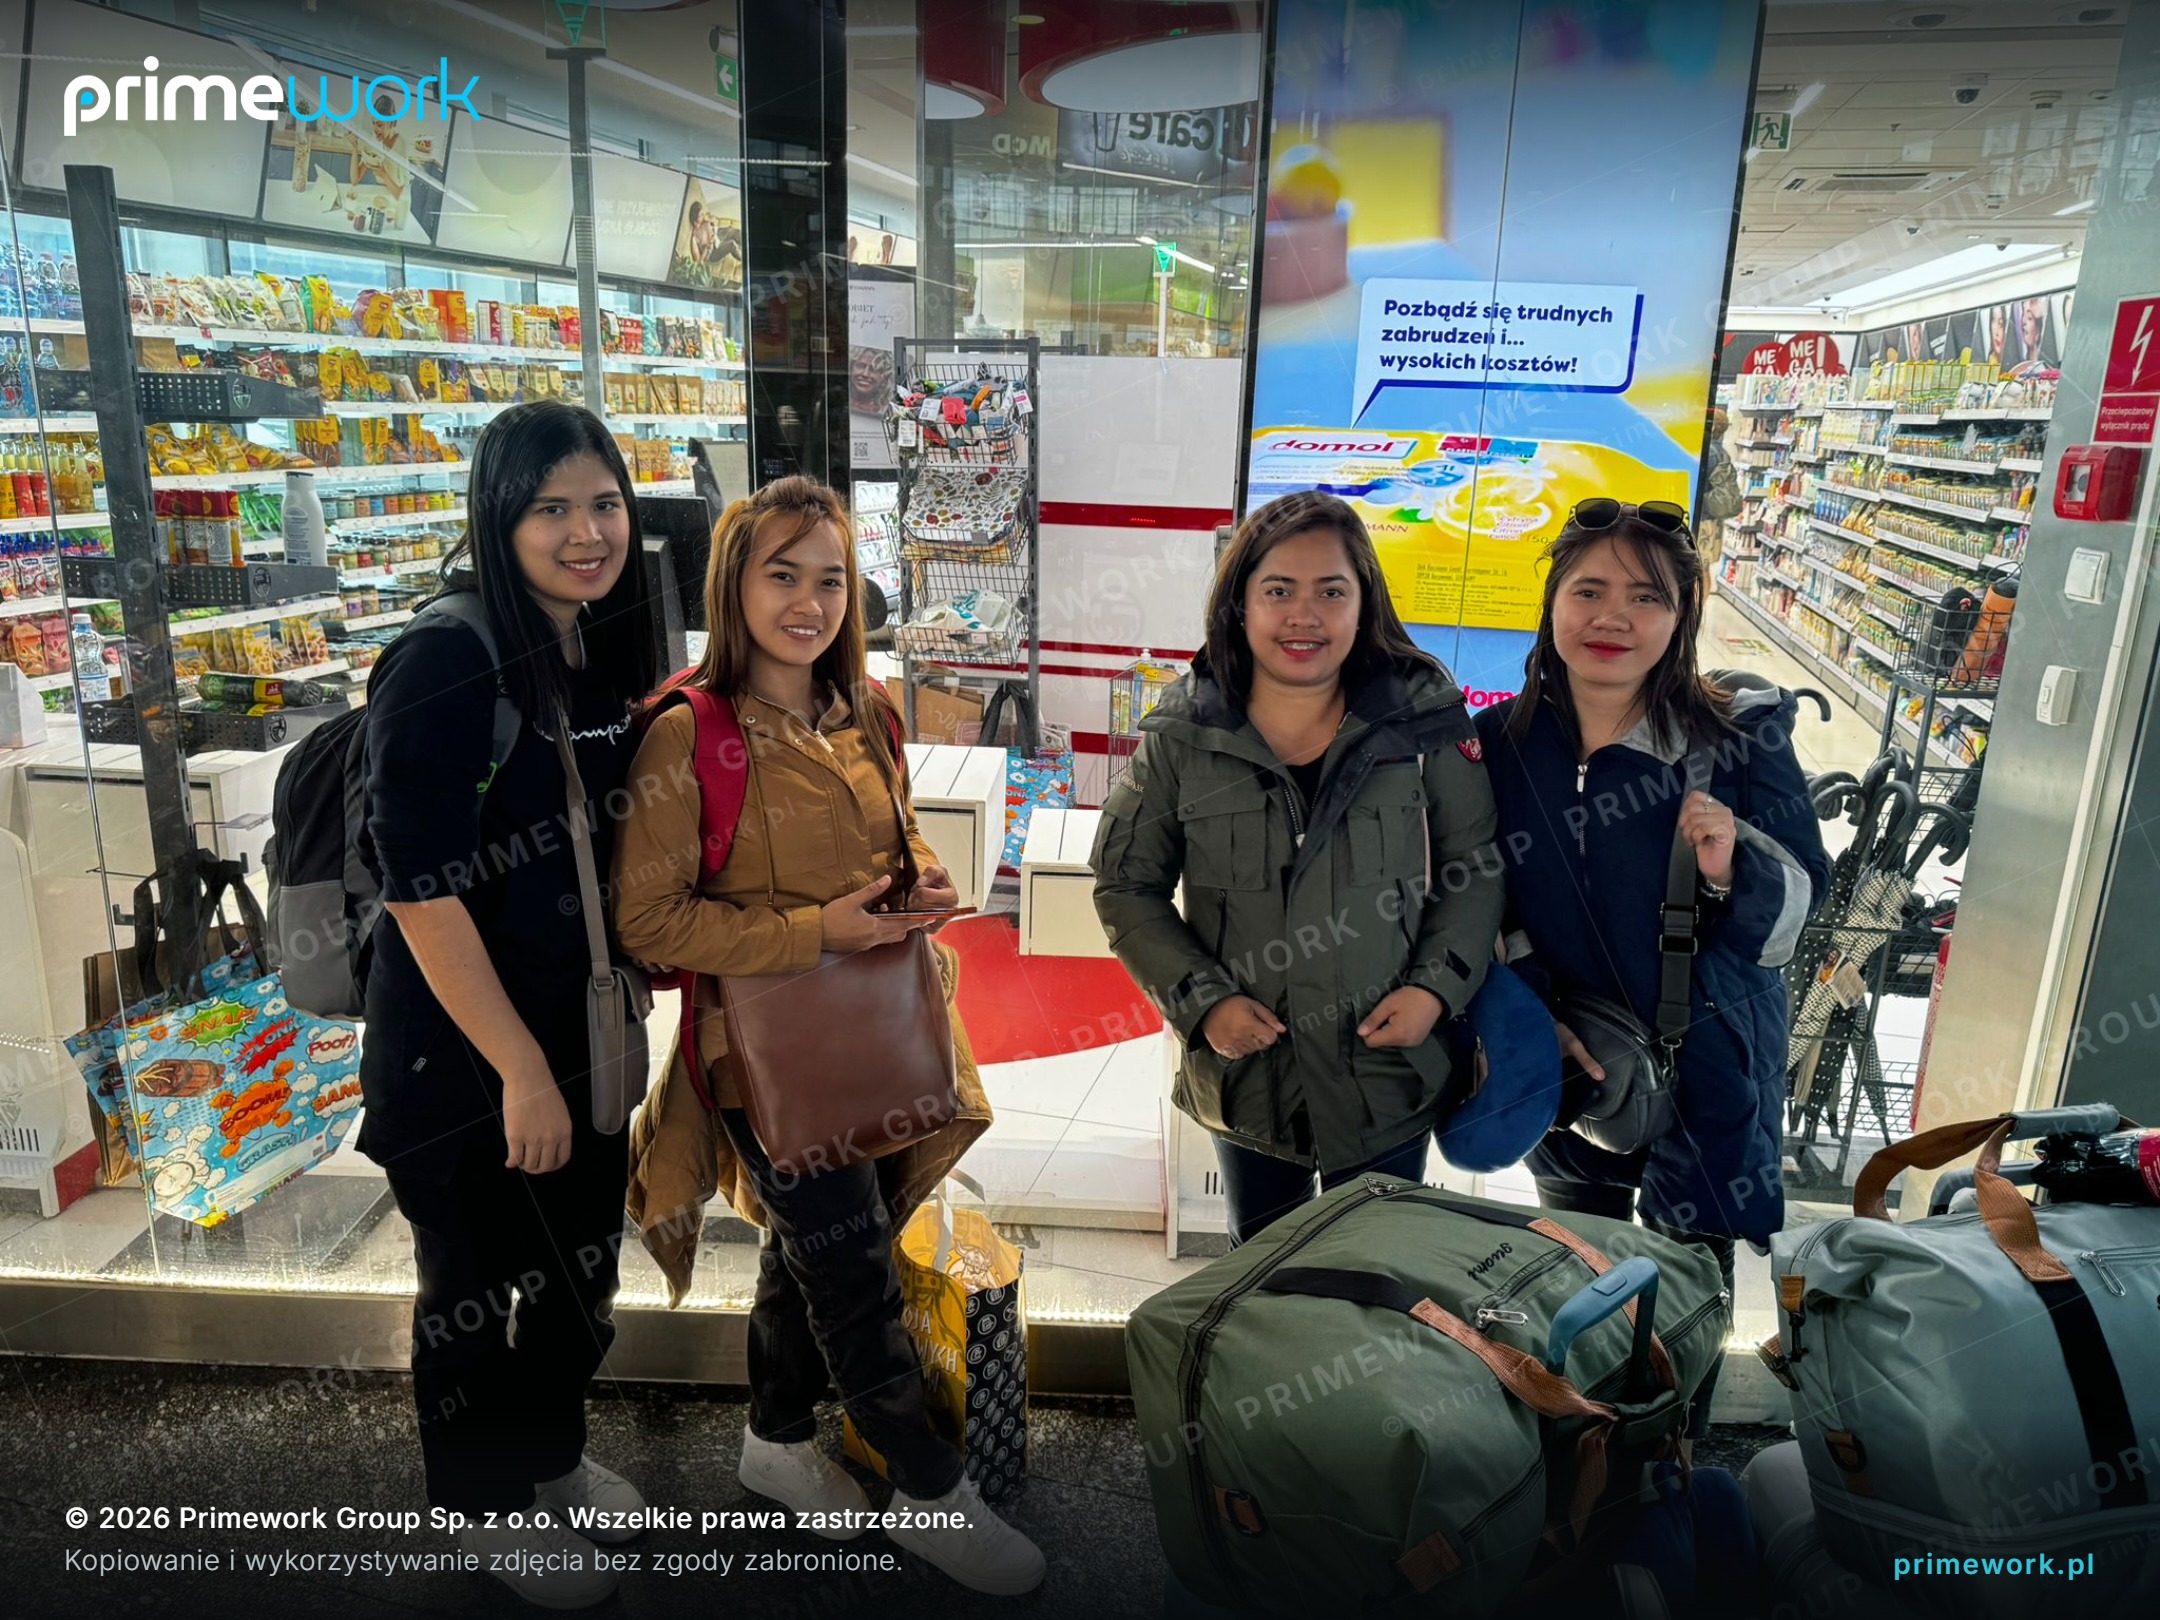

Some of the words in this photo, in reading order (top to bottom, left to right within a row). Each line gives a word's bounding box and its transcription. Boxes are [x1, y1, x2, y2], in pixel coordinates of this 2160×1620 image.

[1383, 299, 1478, 322] Pozbądź
[1482, 302, 1512, 324] się
[1517, 305, 1613, 326] trudnych
[1381, 325, 1495, 345] zabrudzeń
[1754, 349, 1776, 365] ME
[1789, 339, 1815, 358] ME
[1380, 352, 1476, 372] wysokich
[1481, 354, 1578, 373] kosztów!
[1268, 438, 1395, 454] domol
